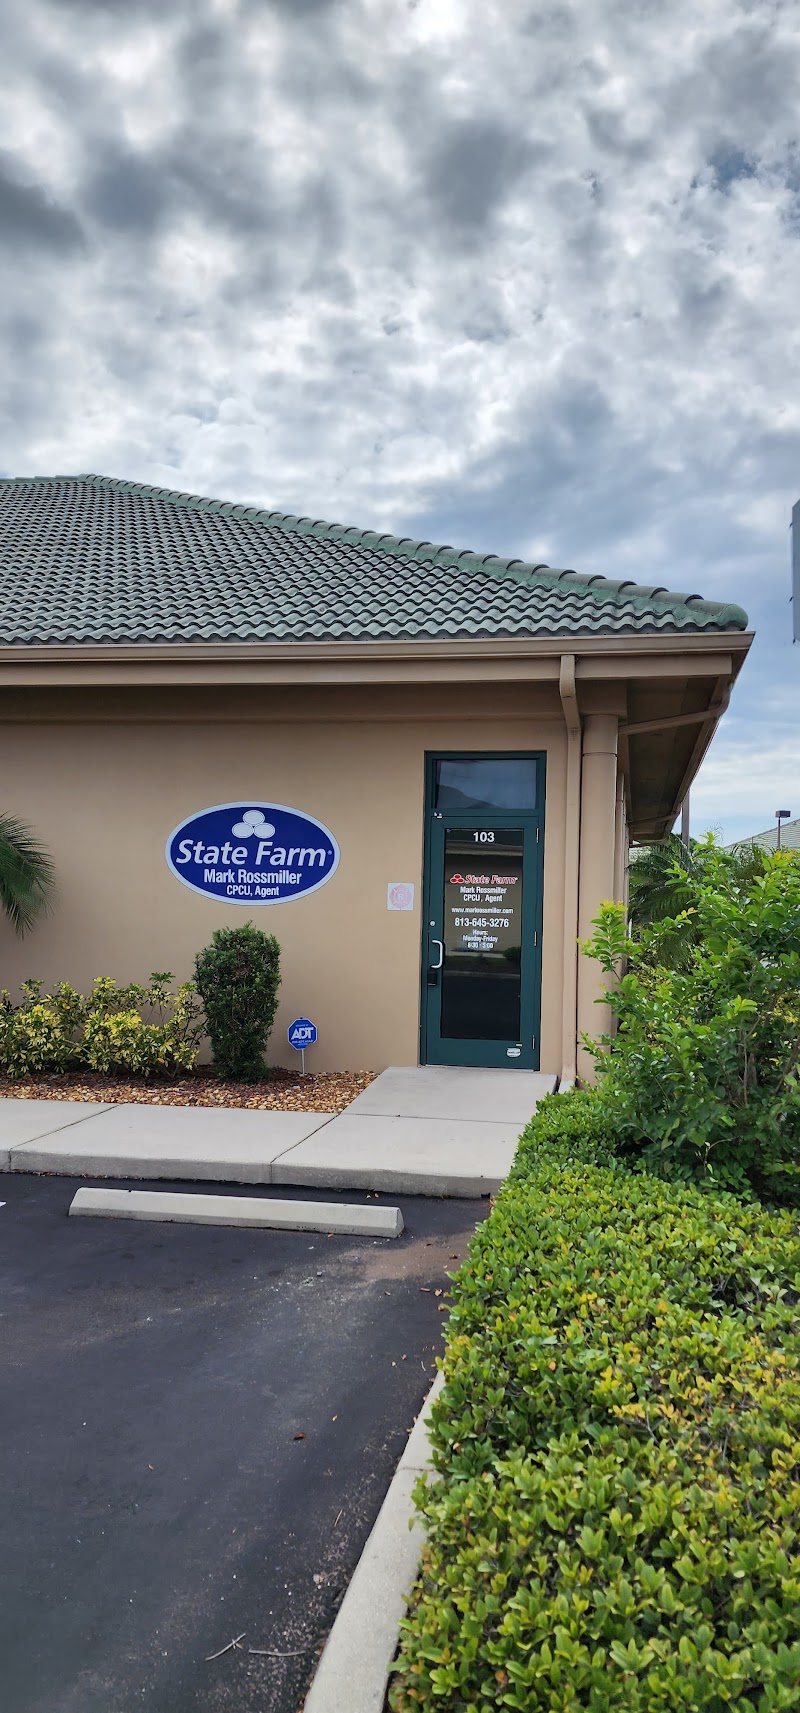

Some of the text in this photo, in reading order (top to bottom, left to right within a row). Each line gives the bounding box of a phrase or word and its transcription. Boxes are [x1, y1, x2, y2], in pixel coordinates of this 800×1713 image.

[473, 832, 495, 842] 103
[175, 839, 327, 867] State Farm
[203, 869, 302, 884] Mark Rossmiller
[465, 874, 516, 885] State Farm
[226, 885, 280, 898] CPCU, Agent
[459, 886, 507, 894] Mark Rossmiller
[485, 894, 503, 903] Agent
[454, 918, 509, 928] 813-645-3276
[291, 1027, 314, 1039] ADT
